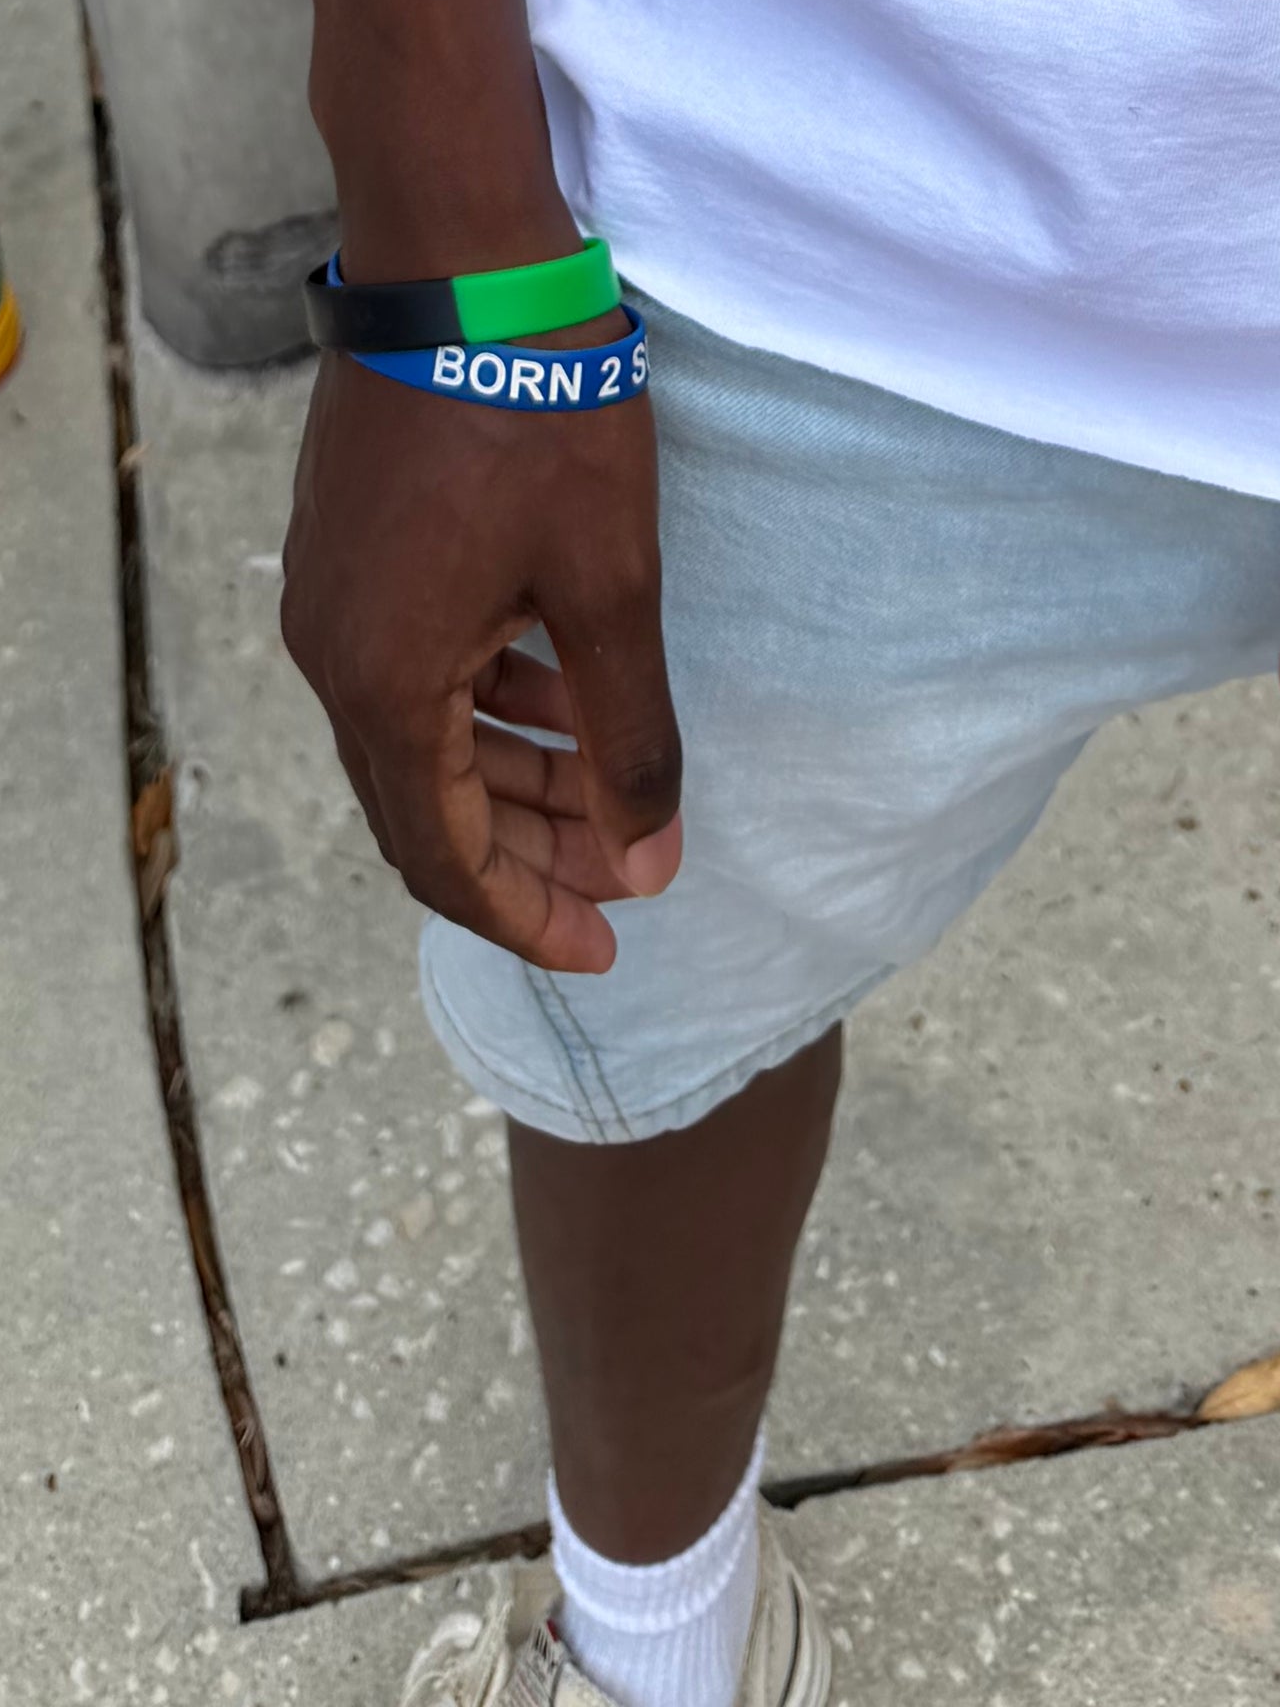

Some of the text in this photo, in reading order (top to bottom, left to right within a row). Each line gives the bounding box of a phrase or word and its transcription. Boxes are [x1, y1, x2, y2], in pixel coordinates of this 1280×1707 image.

[432, 335, 650, 402] BORN 2 S
